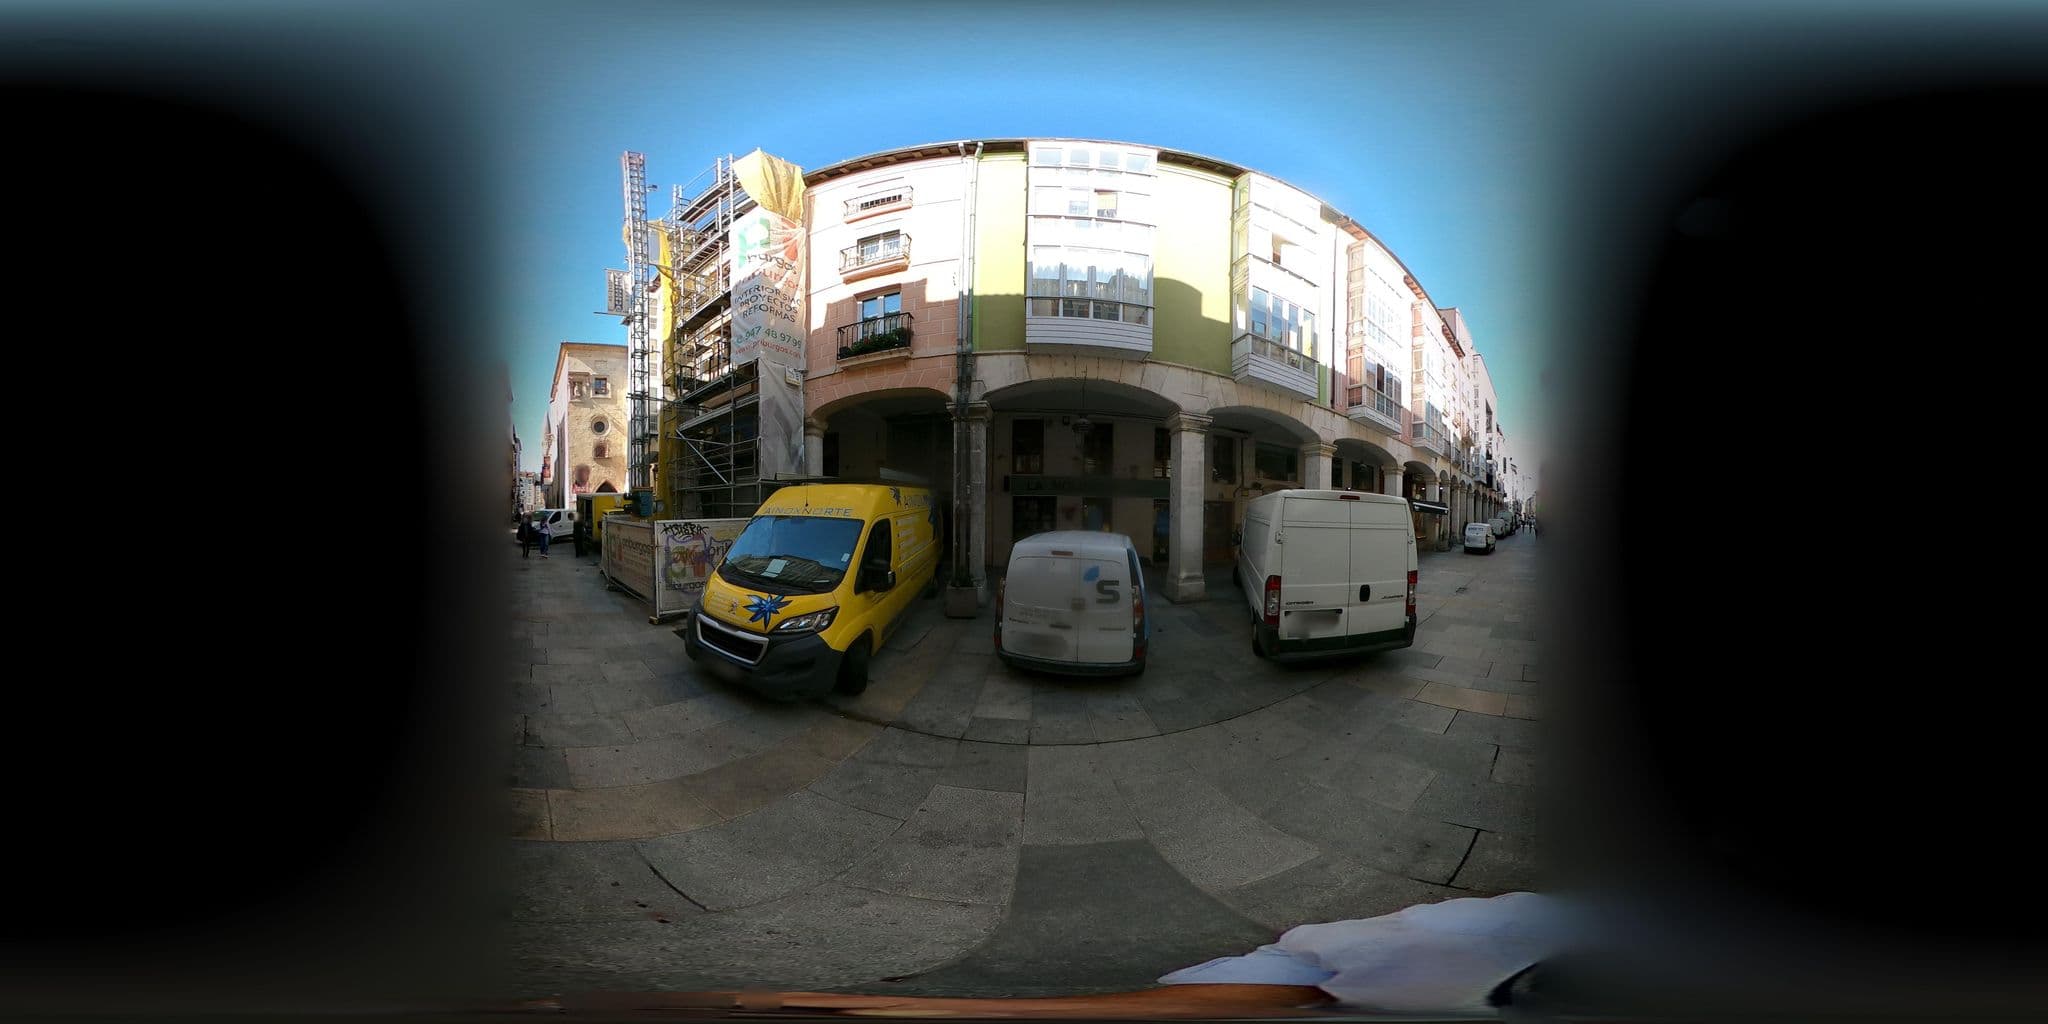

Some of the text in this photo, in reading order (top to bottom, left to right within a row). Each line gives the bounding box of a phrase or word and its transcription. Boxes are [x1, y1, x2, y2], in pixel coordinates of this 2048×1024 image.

[739, 294, 798, 314] PROYECTOS
[742, 304, 796, 323] REFORMAS
[745, 325, 762, 341] 947
[1096, 580, 1120, 604] S
